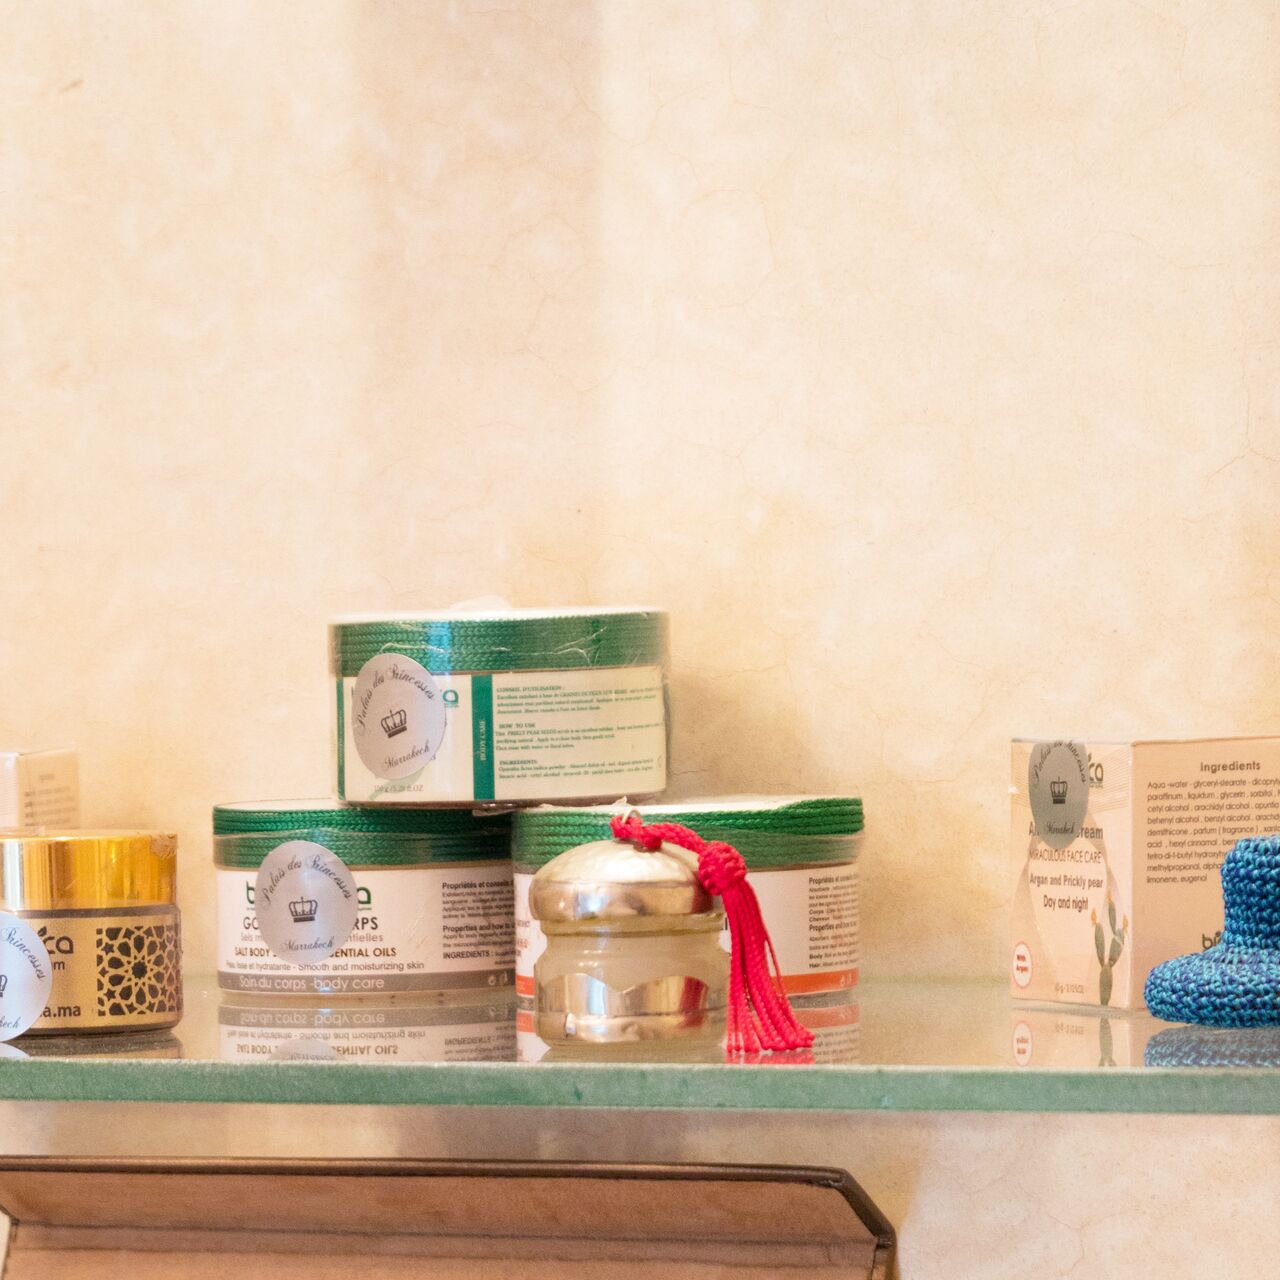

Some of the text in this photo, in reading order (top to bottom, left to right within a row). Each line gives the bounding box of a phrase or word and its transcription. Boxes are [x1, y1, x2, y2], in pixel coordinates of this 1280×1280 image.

[1077, 827, 1104, 839] ream
[1029, 849, 1102, 864] MIRACULOUS FACE CARE
[261, 869, 286, 910] Palais
[287, 854, 302, 871] des
[305, 853, 353, 901] Princesses
[1030, 873, 1104, 891] Argan and Prickly pear
[1043, 895, 1089, 913] Day and night
[354, 917, 379, 931] RPS
[279, 936, 335, 952] Marrakech
[345, 932, 384, 943] ntielles
[0, 926, 46, 980] Princesses
[250, 947, 270, 958] BODY
[329, 947, 370, 958] ENTIAL
[373, 946, 397, 957] OILS
[442, 949, 490, 960] INGREDIENTS
[332, 961, 349, 971] and
[351, 961, 405, 973] moisturizing
[407, 961, 425, 970] skin
[274, 979, 306, 991] corps
[352, 978, 385, 989] care
